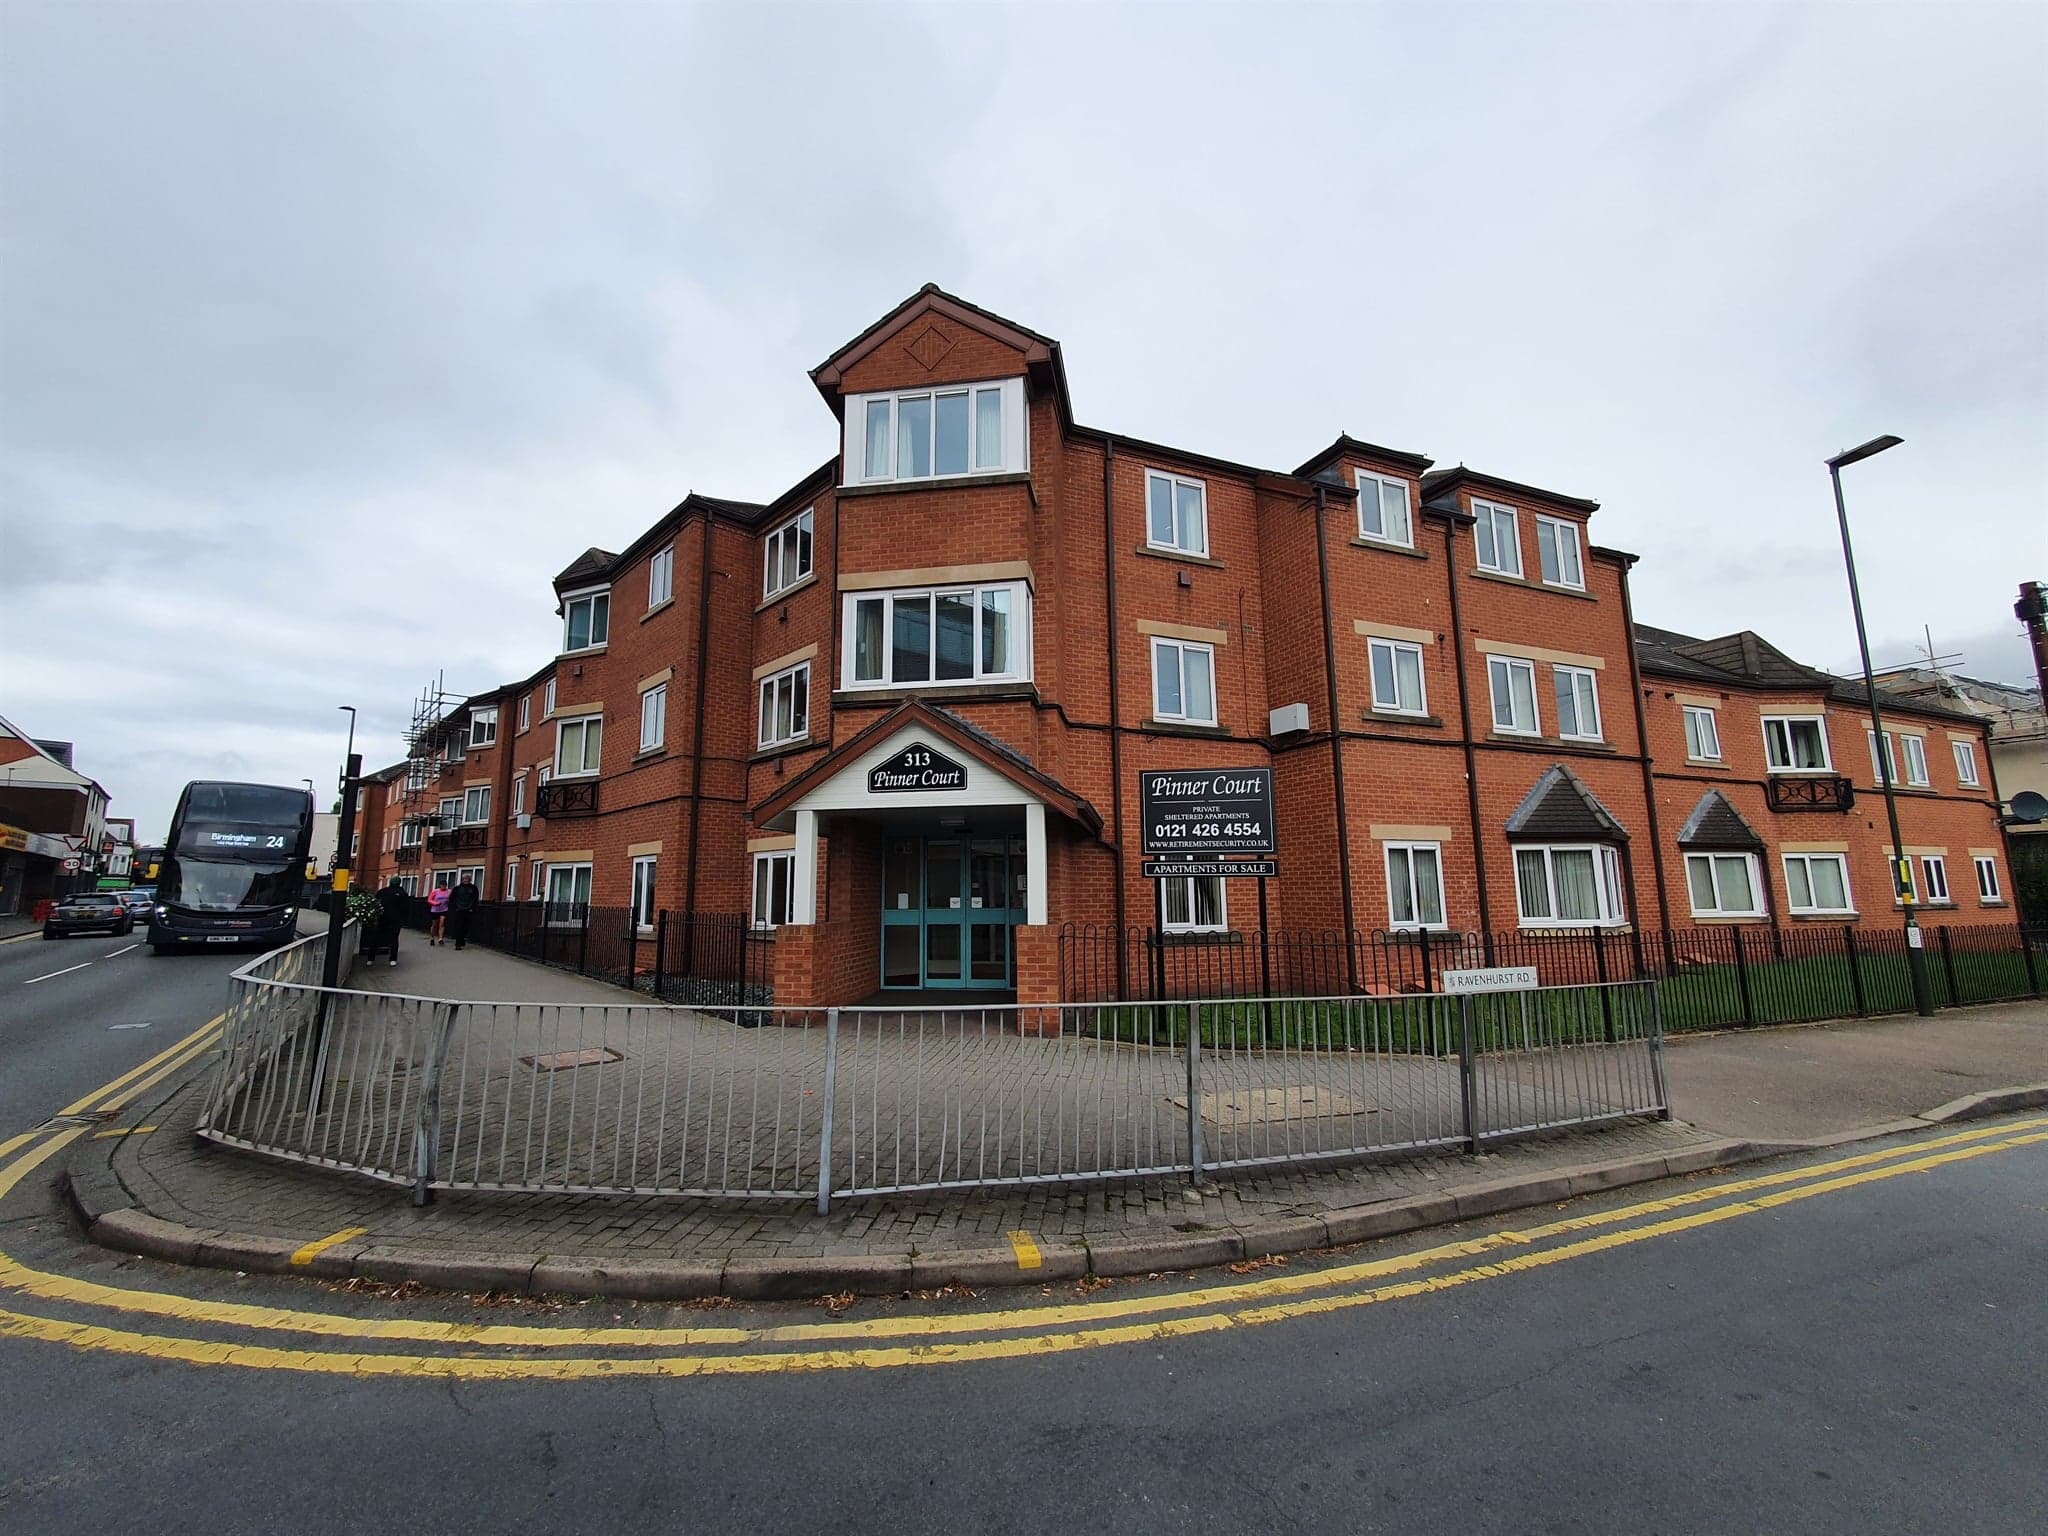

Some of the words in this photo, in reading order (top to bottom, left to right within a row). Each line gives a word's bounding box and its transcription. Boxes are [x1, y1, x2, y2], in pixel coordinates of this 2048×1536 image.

[904, 752, 931, 767] 313
[873, 770, 920, 787] Pinner
[921, 769, 960, 786] Court
[1151, 776, 1209, 796] Pinner
[1212, 775, 1262, 795] Court
[1164, 813, 1204, 821] SHELTERED
[1204, 812, 1250, 820] APARTMENTS
[1155, 824, 1187, 837] 0121
[1192, 823, 1220, 837] 426
[1223, 822, 1261, 836] 4554
[211, 832, 257, 842] Birmingham
[266, 835, 284, 848] 24
[1149, 839, 1269, 848] WWW.RETIREMENTSECURITY.CO.UK
[1153, 865, 1217, 873] APARTMENTS
[1219, 865, 1239, 873] FOR
[1240, 864, 1266, 873] SALE
[1457, 973, 1514, 986] RAVENHURST
[1517, 972, 1530, 983] RD
